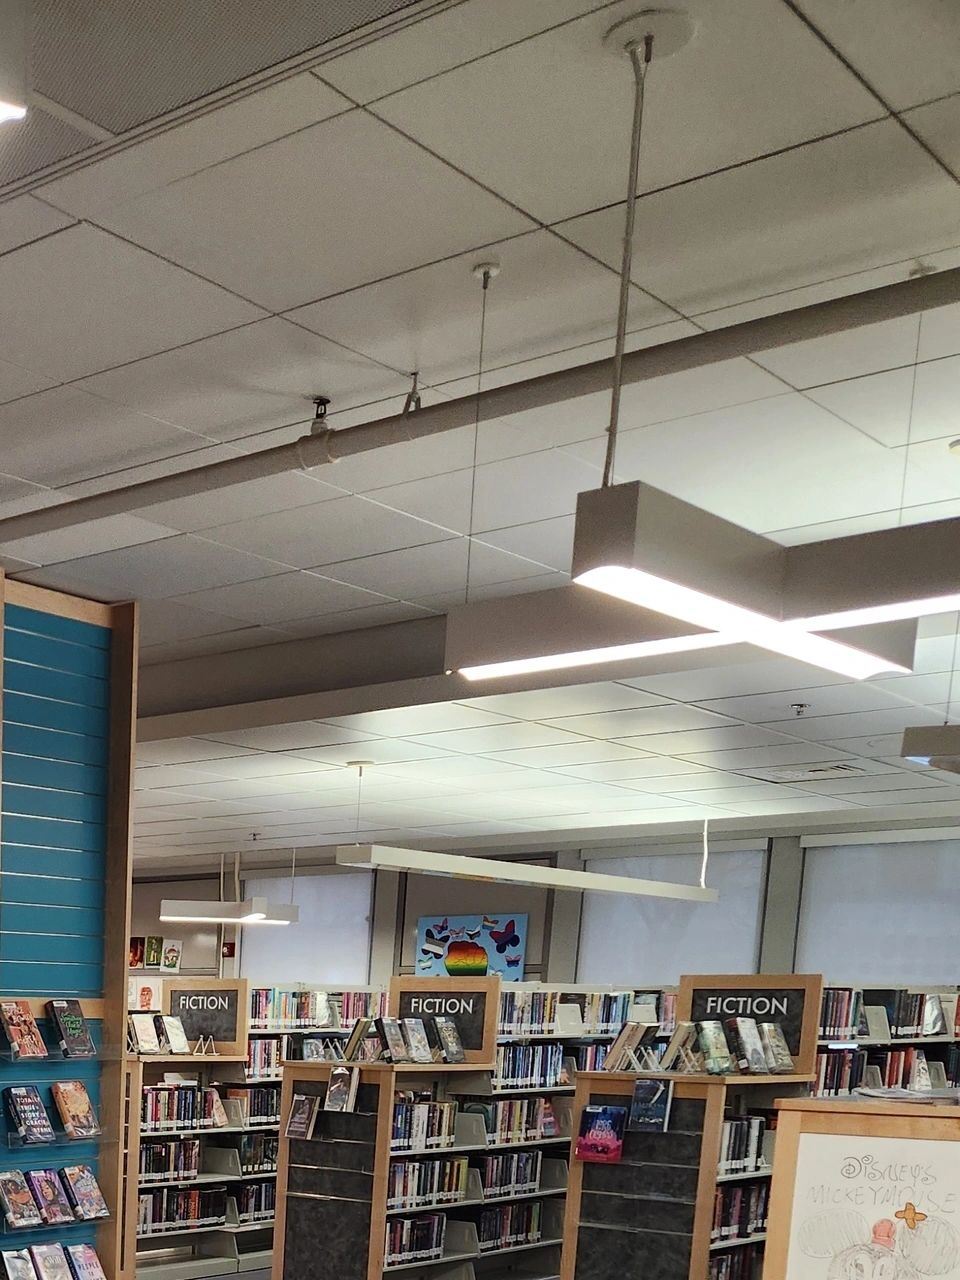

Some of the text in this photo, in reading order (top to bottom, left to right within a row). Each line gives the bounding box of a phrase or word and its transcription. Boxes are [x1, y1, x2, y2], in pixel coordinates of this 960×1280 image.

[180, 996, 229, 1010] FICTION
[411, 998, 473, 1014] FICTION
[706, 997, 788, 1015] FICTION
